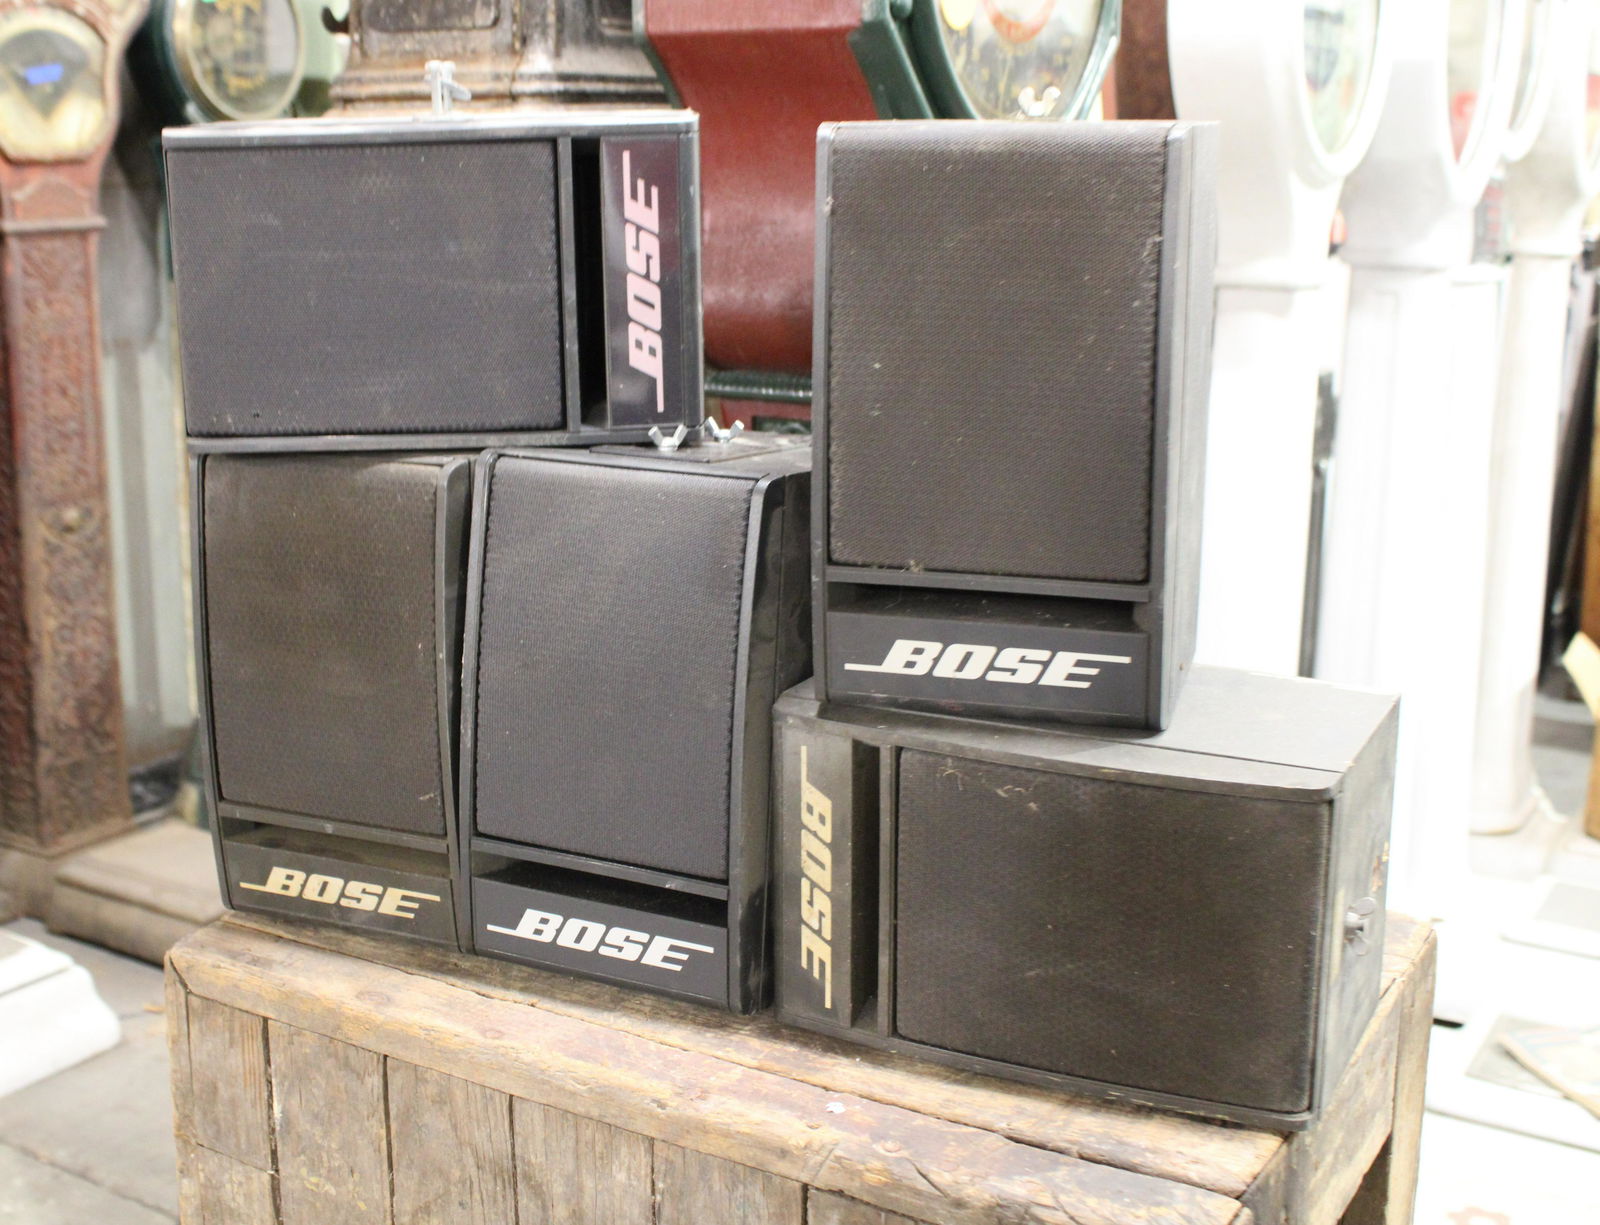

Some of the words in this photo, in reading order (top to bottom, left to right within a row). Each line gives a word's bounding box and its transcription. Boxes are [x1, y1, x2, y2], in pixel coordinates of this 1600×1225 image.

[622, 150, 666, 413] BOSE
[844, 638, 1132, 690] BOSE
[239, 866, 441, 919] BOSE
[801, 745, 832, 1009] BOSE
[486, 907, 715, 972] BOSE
